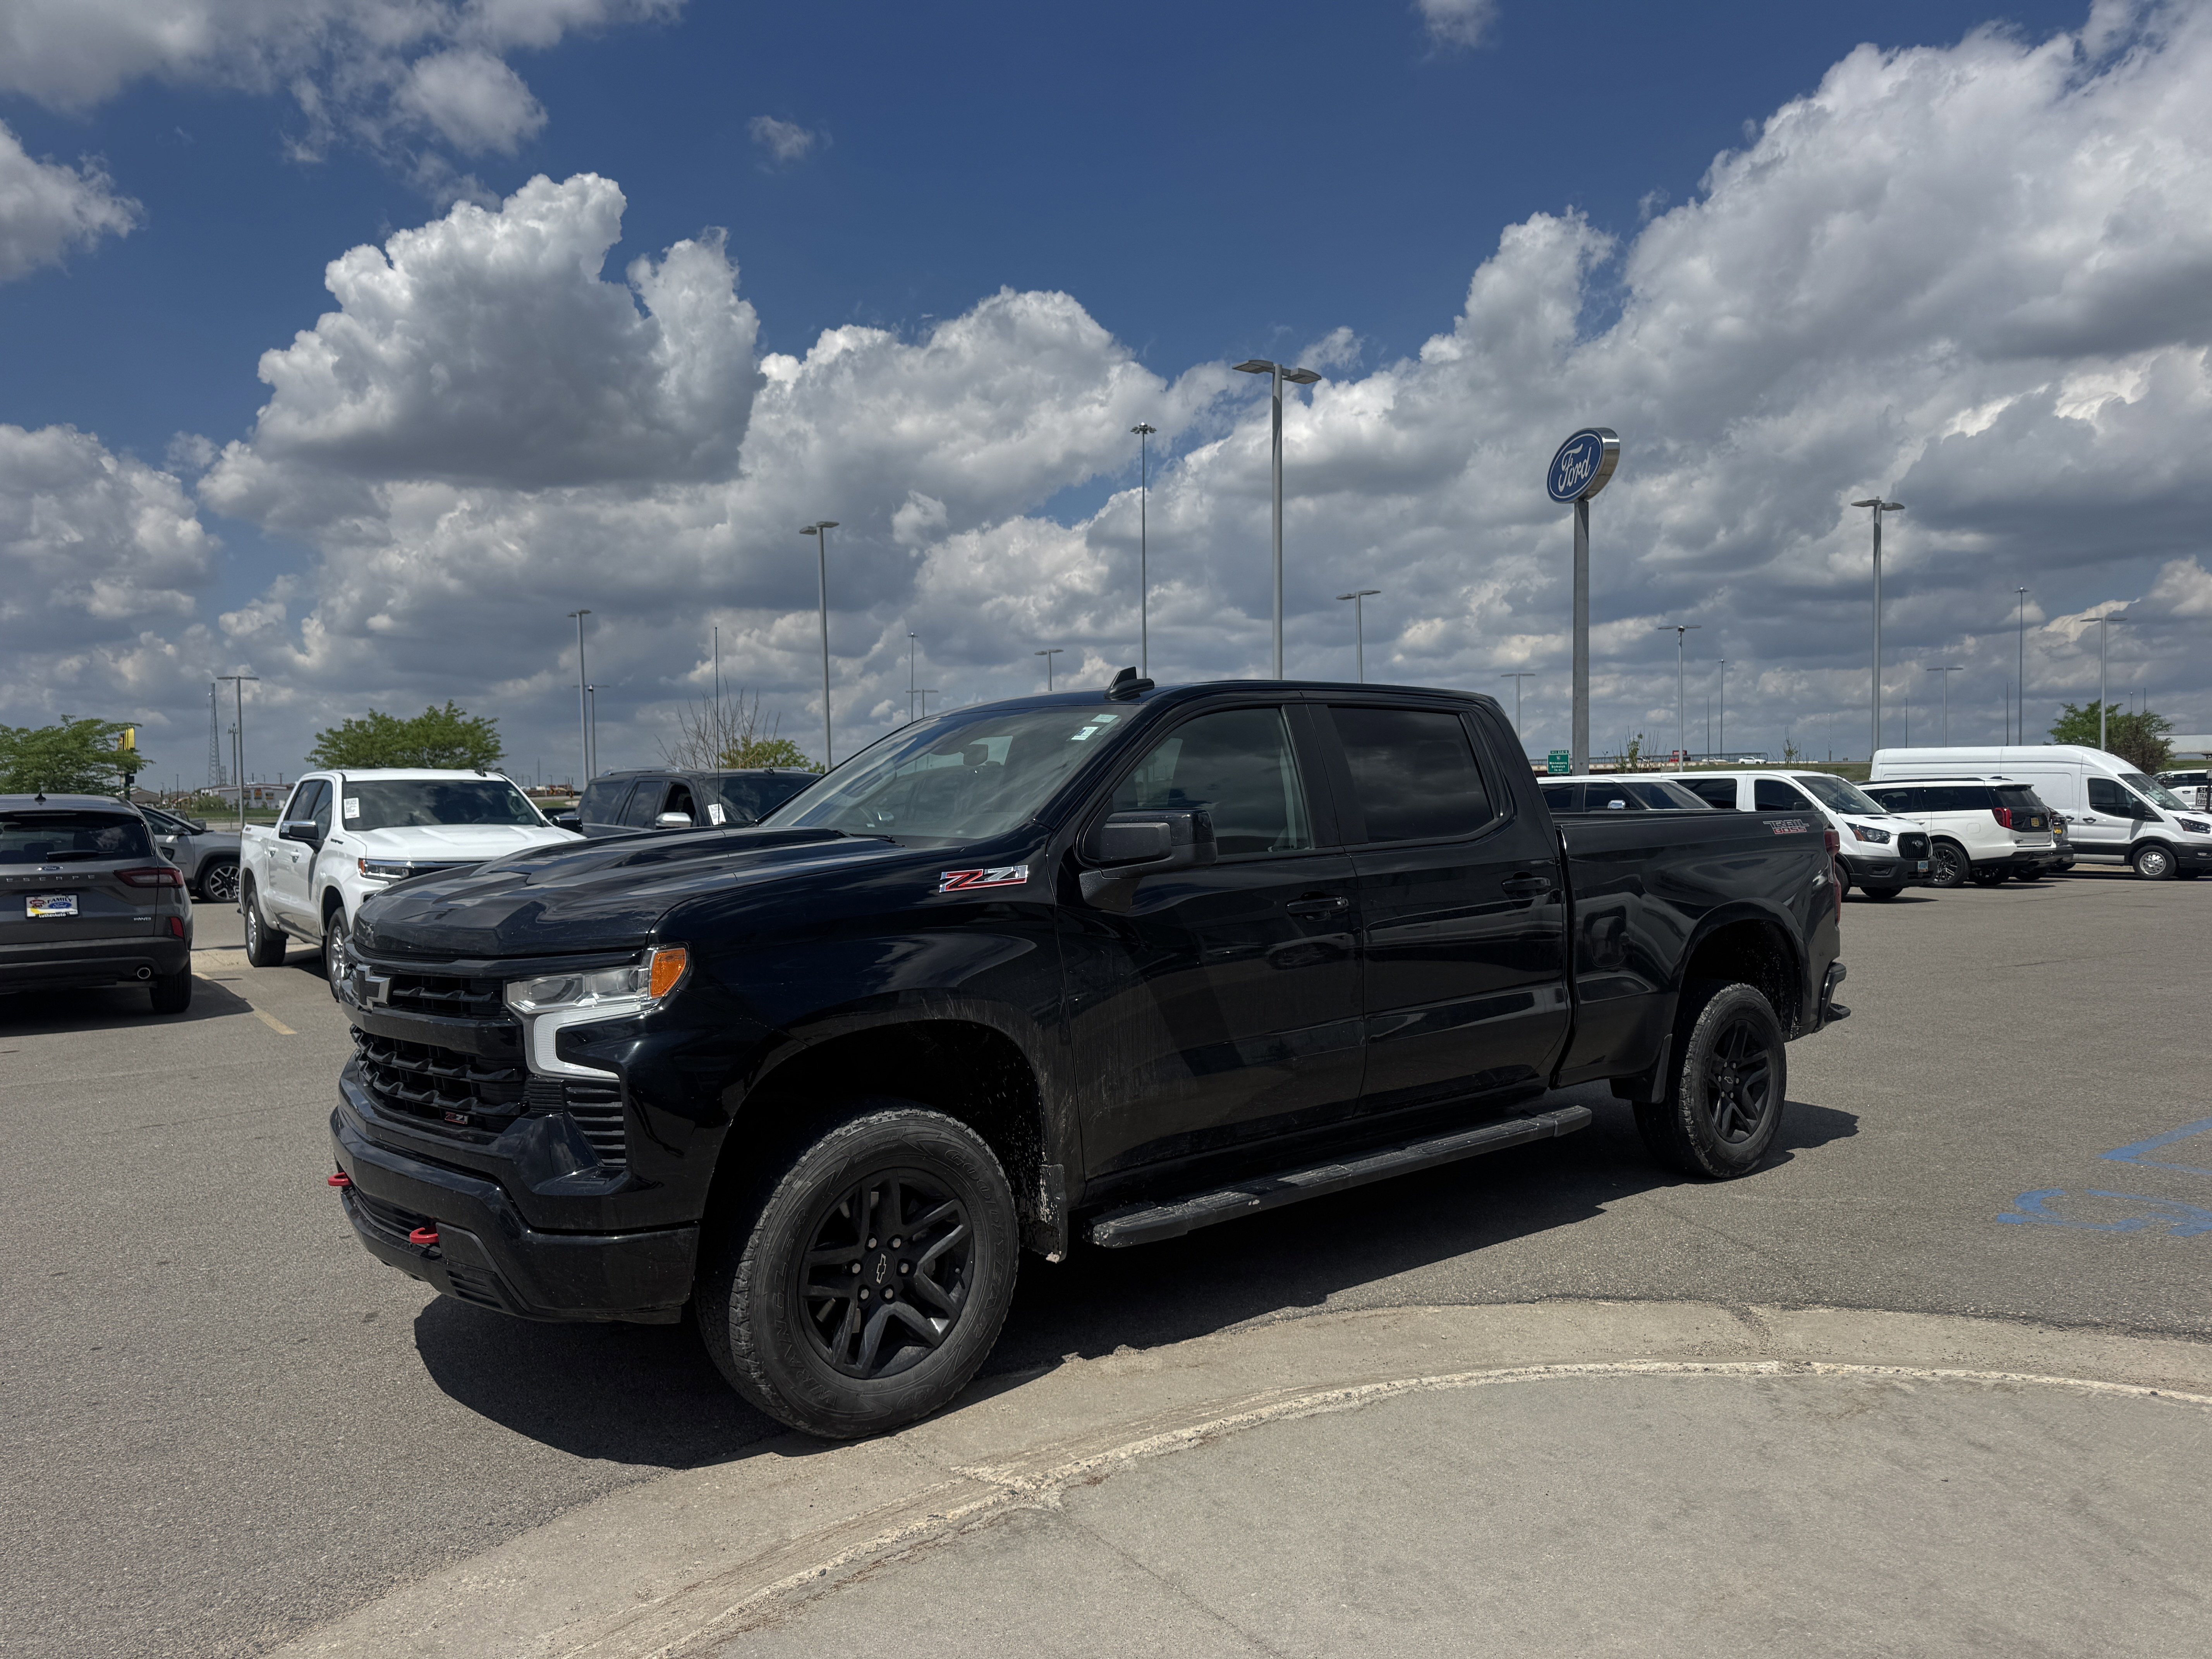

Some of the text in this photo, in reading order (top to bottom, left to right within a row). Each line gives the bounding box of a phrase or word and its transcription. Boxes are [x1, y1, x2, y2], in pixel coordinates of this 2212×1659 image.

[1558, 443, 1592, 492] Ford
[1763, 819, 1810, 829] TRAIL
[939, 865, 1028, 893] Z71
[445, 1111, 469, 1125] Z71
[945, 1150, 1005, 1339] GOODYEAR
[773, 1208, 839, 1406] WRANGLER
